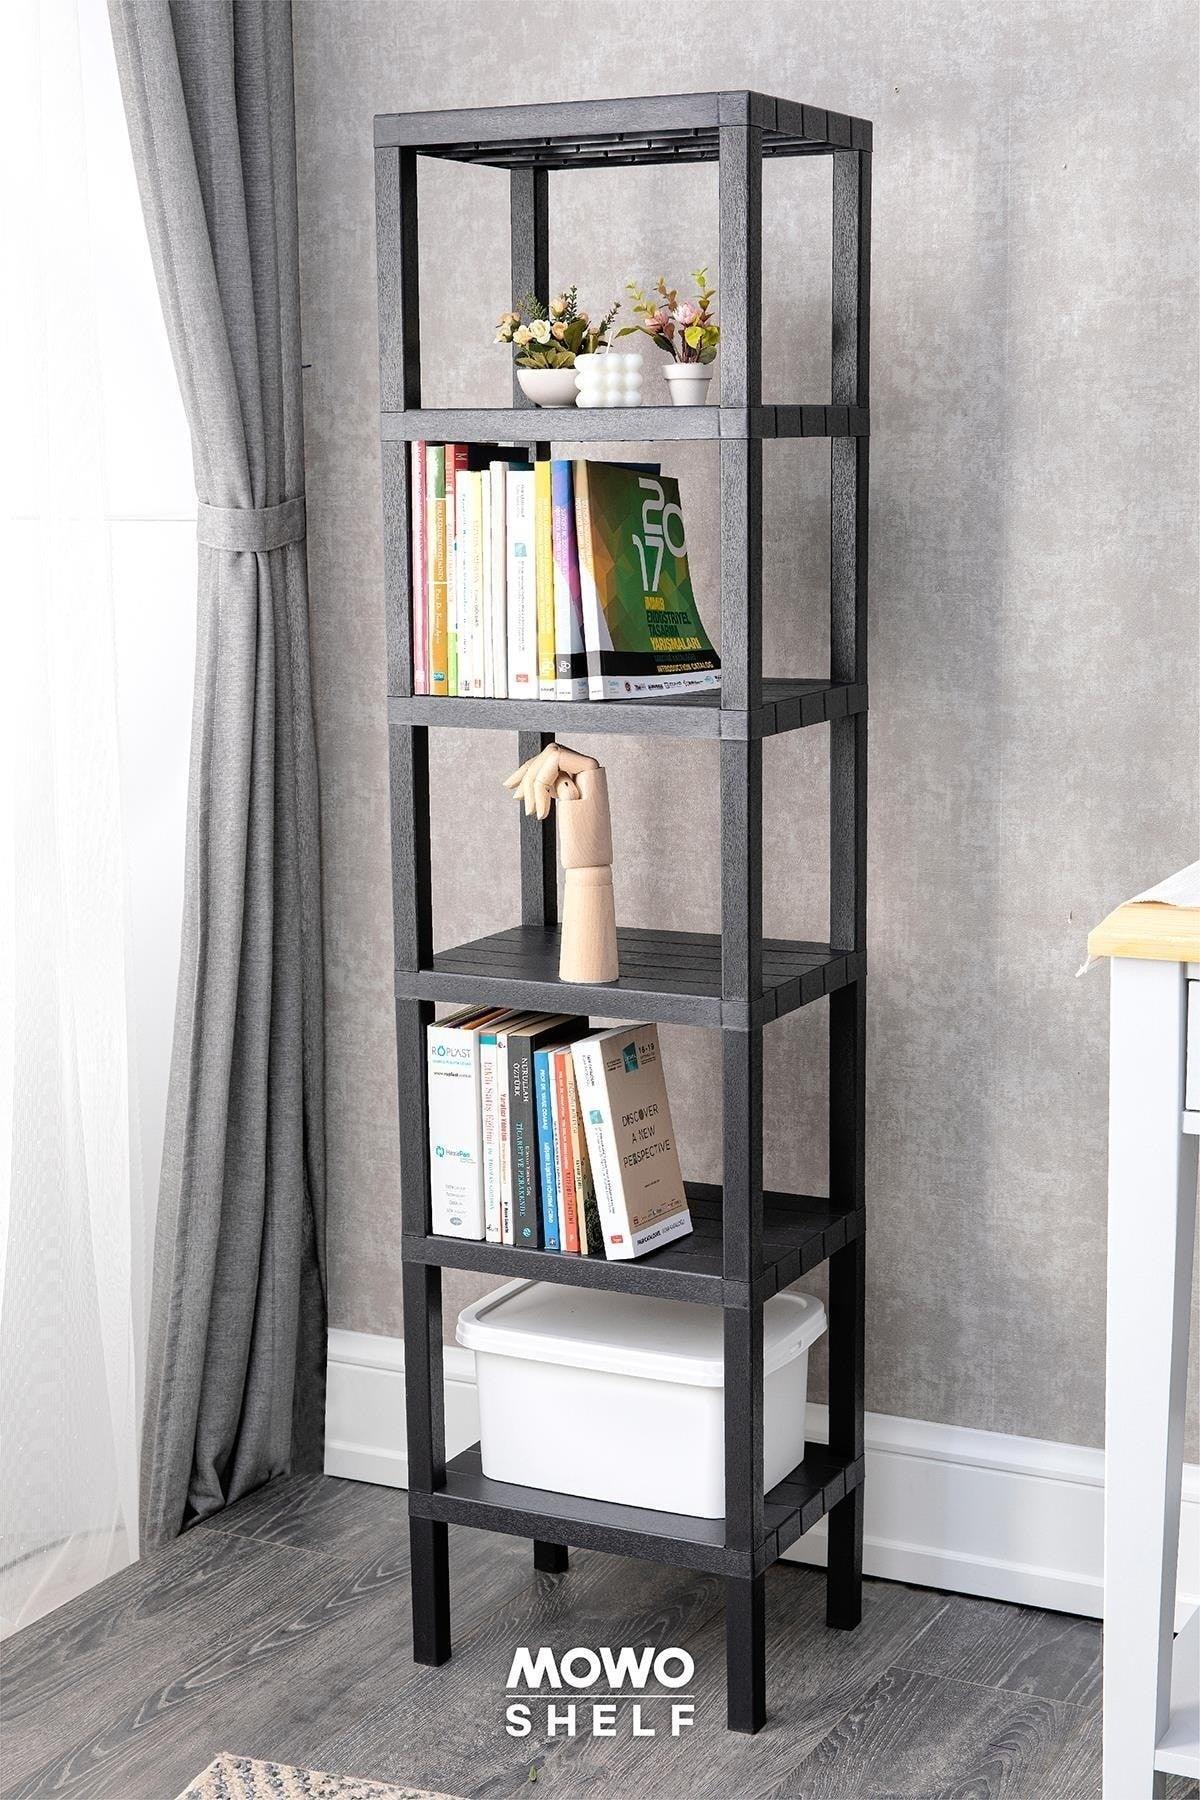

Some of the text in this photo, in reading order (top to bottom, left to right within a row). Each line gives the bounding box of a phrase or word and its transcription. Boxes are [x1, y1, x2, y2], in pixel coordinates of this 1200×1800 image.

[622, 1103, 659, 1128] DISCOVER
[631, 1127, 656, 1143] A NEW
[623, 1139, 671, 1169] PERSPECTIVE
